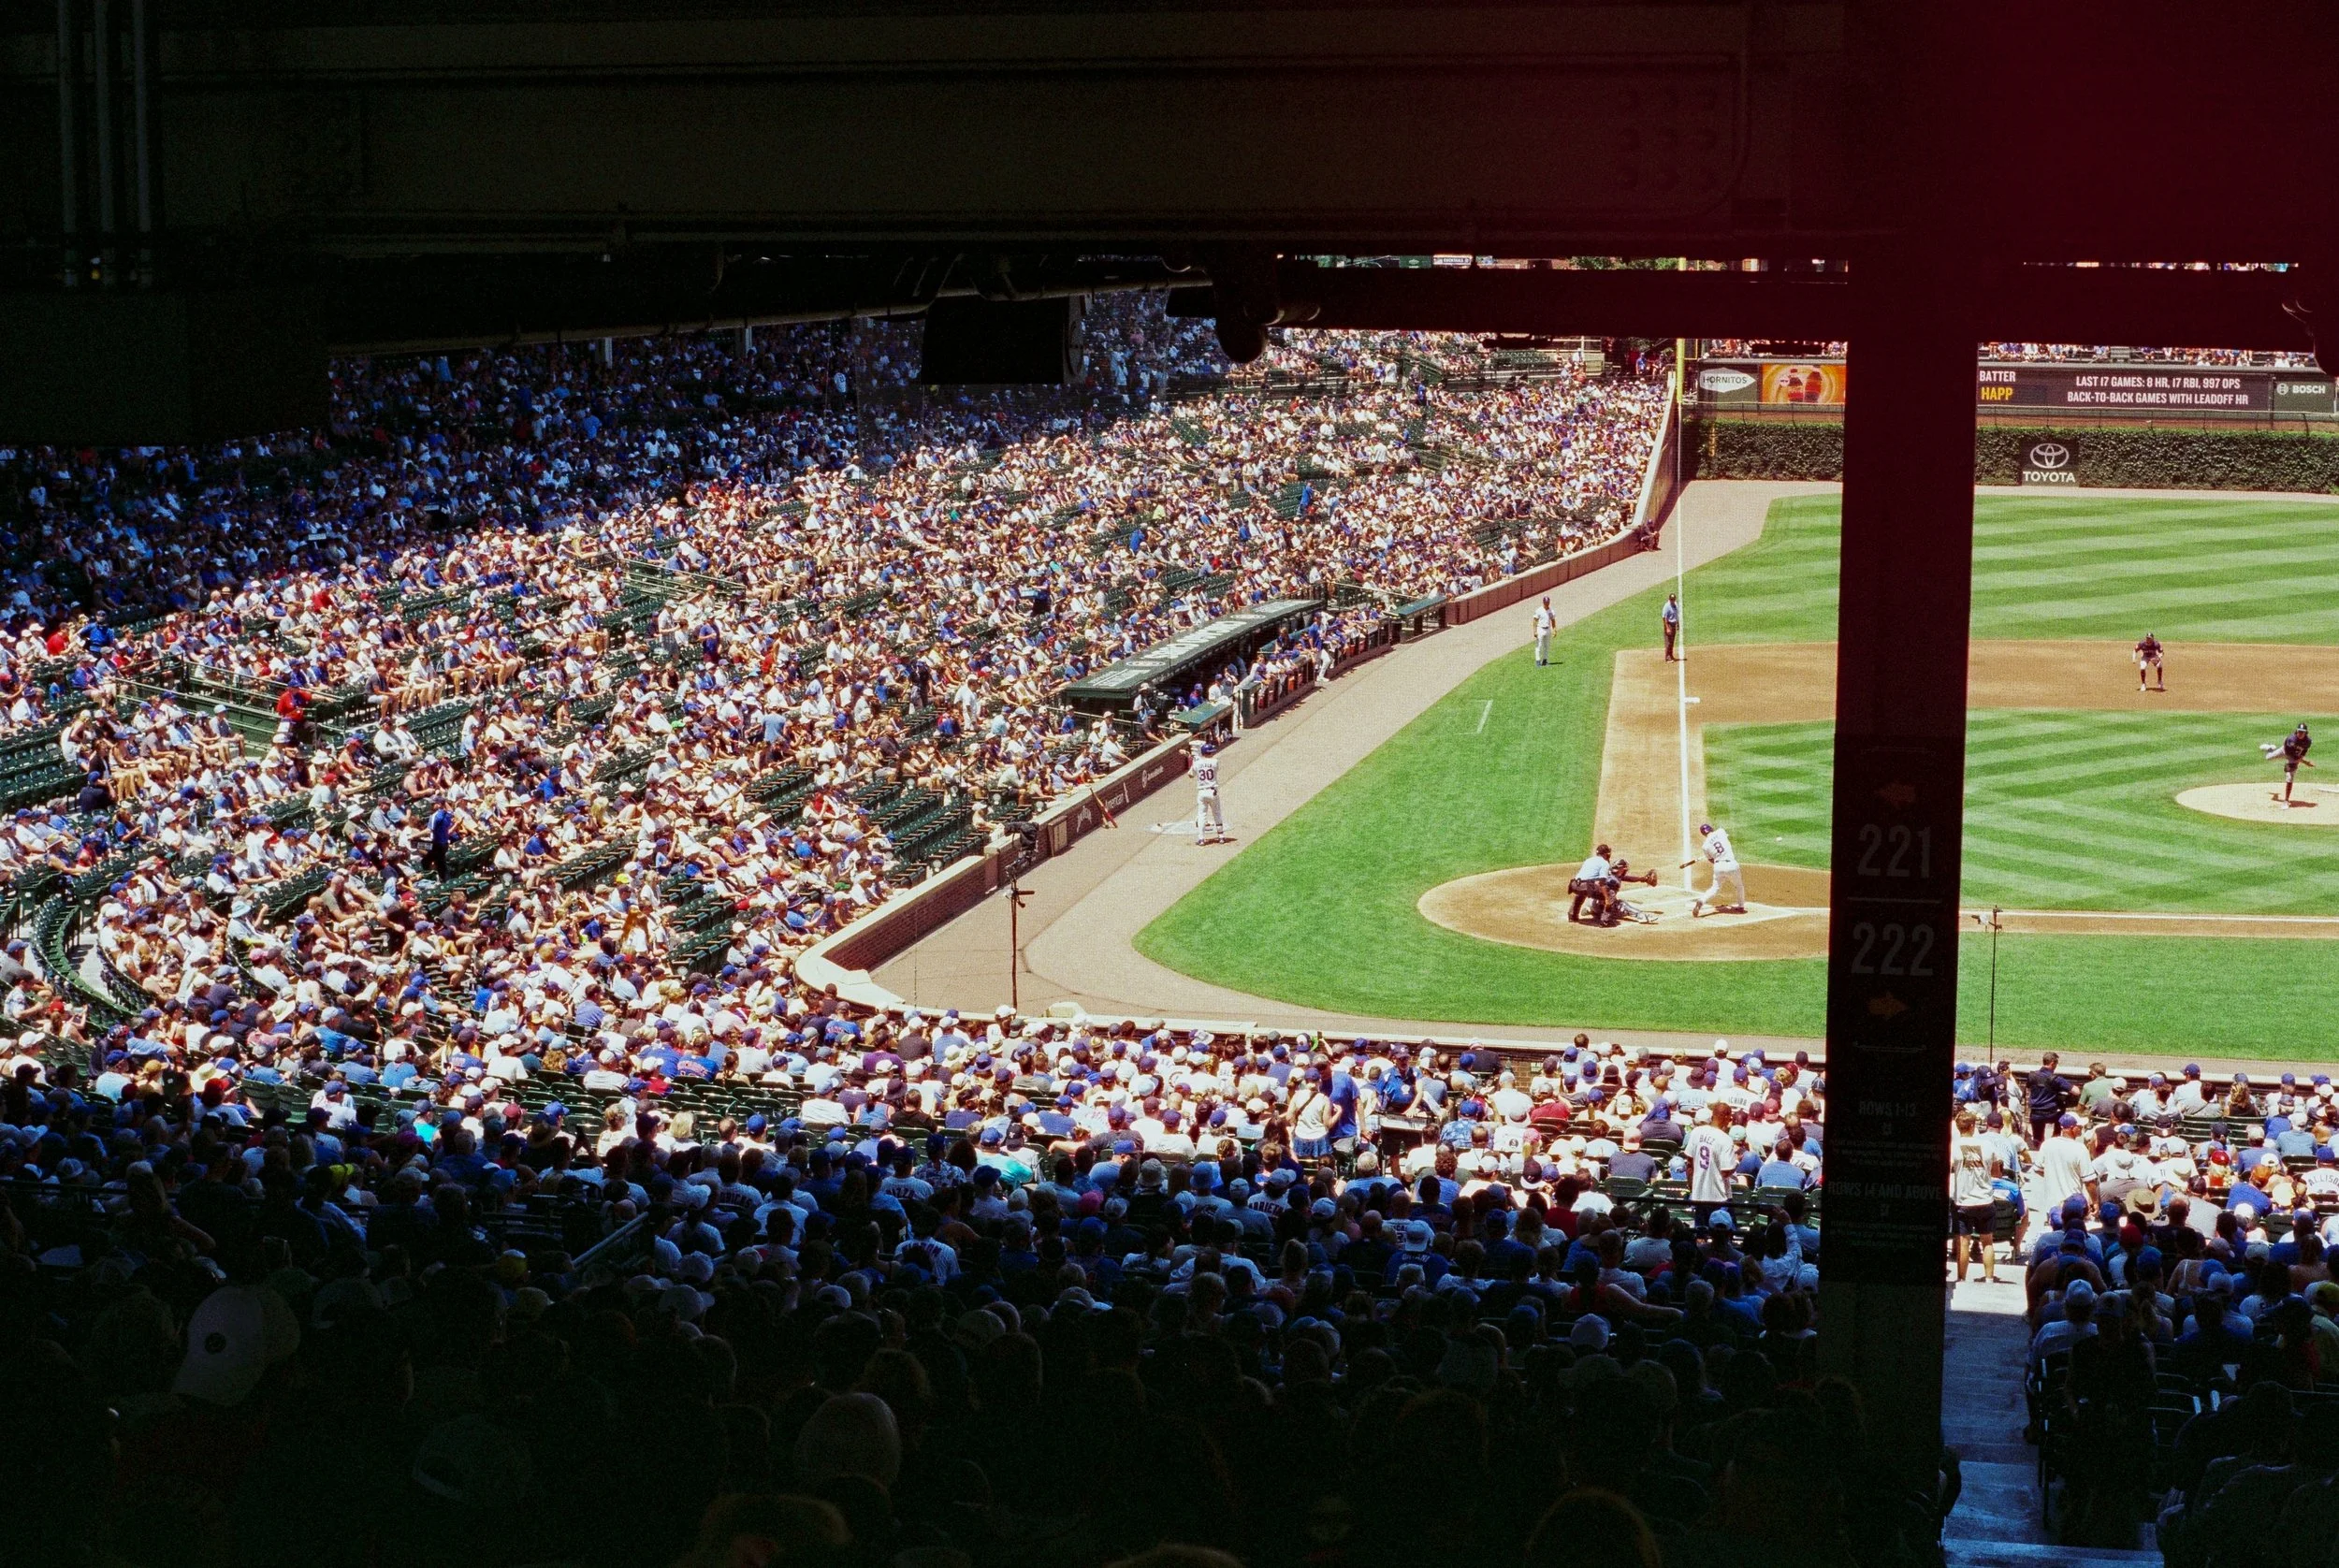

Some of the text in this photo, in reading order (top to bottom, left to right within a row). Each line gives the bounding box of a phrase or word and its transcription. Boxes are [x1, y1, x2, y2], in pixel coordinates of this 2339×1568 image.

[1703, 375, 1748, 384] HORNITOS
[1979, 370, 2016, 383] BATTER
[2076, 376, 2099, 386] LAST
[2100, 376, 2108, 386] 17
[2111, 376, 2145, 387] GAMES:
[2146, 377, 2153, 387] 8
[2155, 377, 2170, 388] HR,
[2172, 377, 2181, 388] 17
[2202, 378, 2220, 388] 997
[2222, 378, 2241, 389] OPS
[1981, 386, 2013, 400] HAPP
[2292, 384, 2326, 394] BOSCH
[2067, 391, 2249, 405] BACK-TO-BACK GAMES WITH LEADOFF HR
[2022, 471, 2076, 483] TOYOTA
[1199, 768, 1214, 781] 30
[1857, 822, 1932, 878] 221
[1850, 921, 1935, 977] 222
[1858, 1100, 1893, 1117] ROWS
[1699, 1145, 1710, 1169] 9
[1827, 1181, 1862, 1197] ROWS
[1879, 1183, 1903, 1198] AND
[1904, 1184, 1943, 1200] ABOVE
